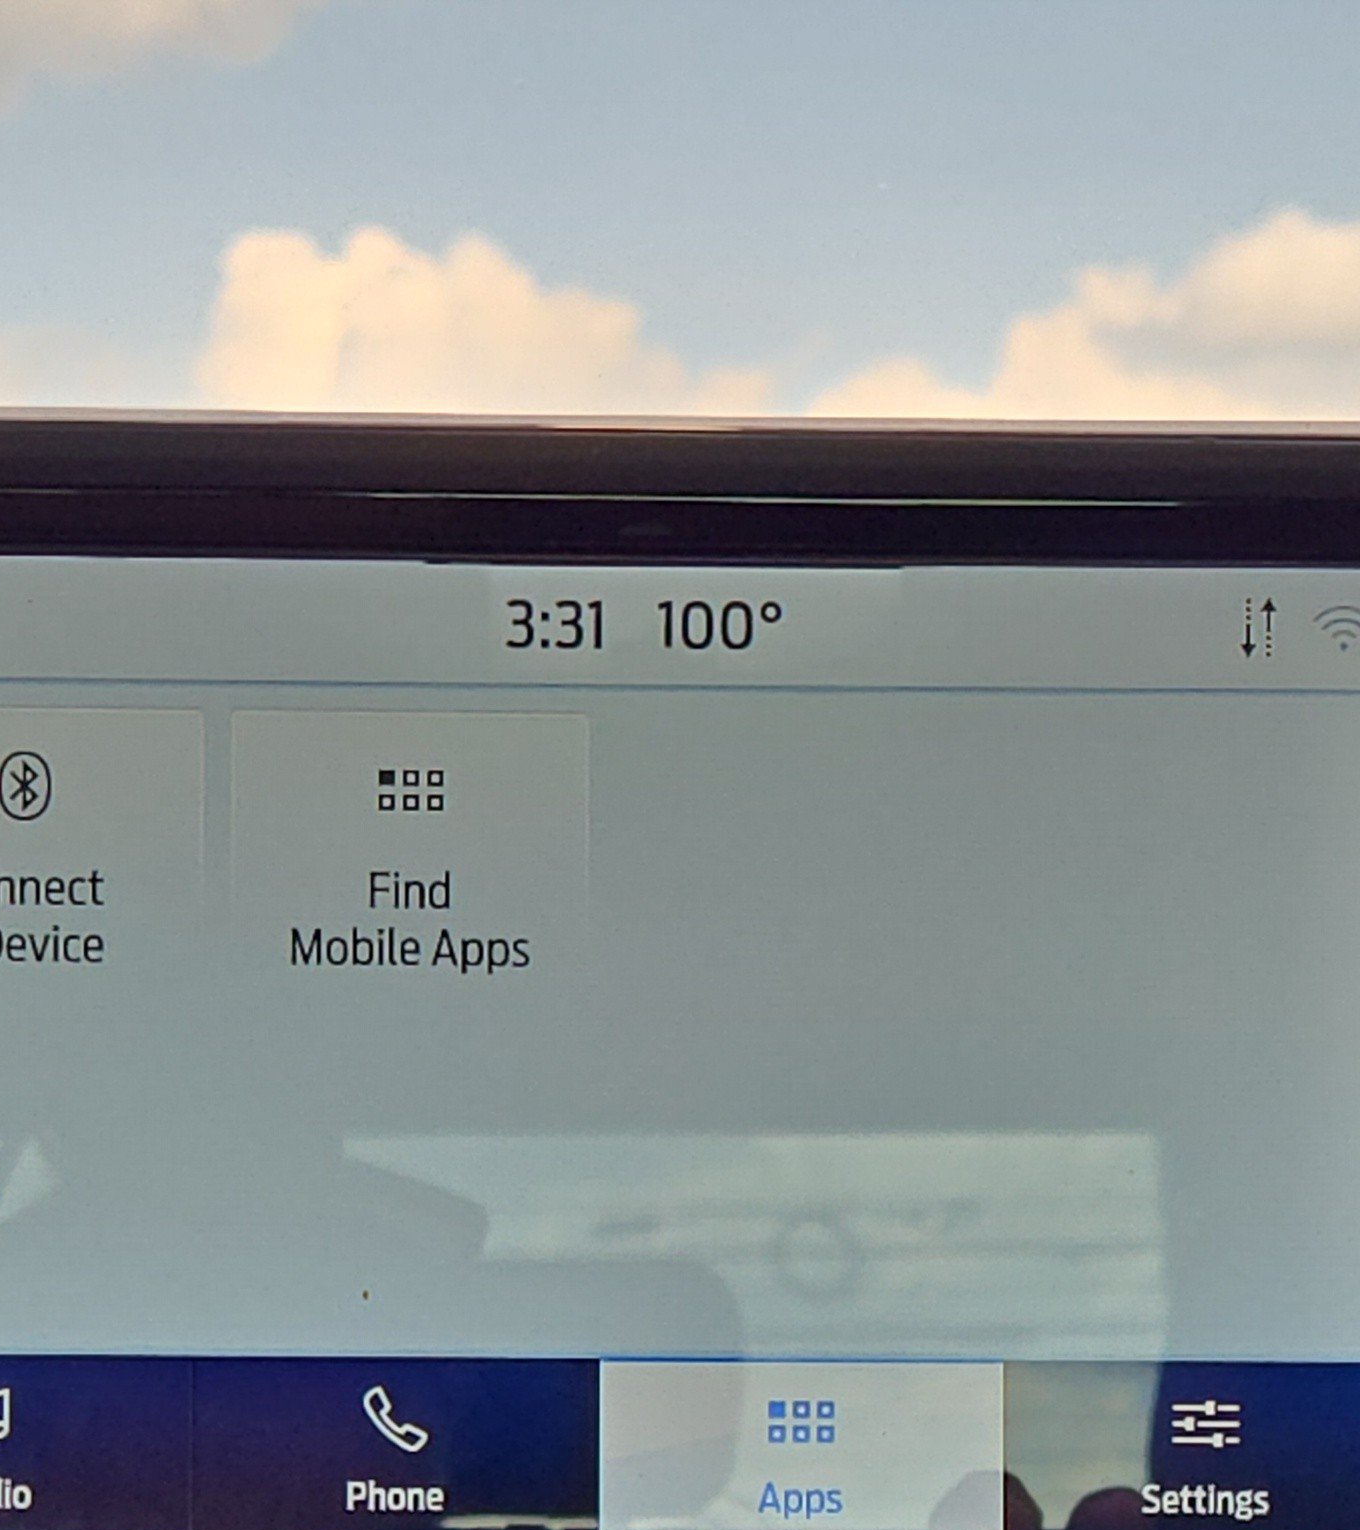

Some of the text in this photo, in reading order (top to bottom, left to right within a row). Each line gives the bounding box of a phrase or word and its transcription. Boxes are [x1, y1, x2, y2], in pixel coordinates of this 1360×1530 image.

[506, 599, 782, 650] 3:31 100°
[369, 870, 450, 910] Find
[291, 926, 530, 975] Mobile Apps
[345, 1479, 444, 1513] Phone
[757, 1481, 843, 1519] Apps
[1141, 1483, 1270, 1519] Settings
